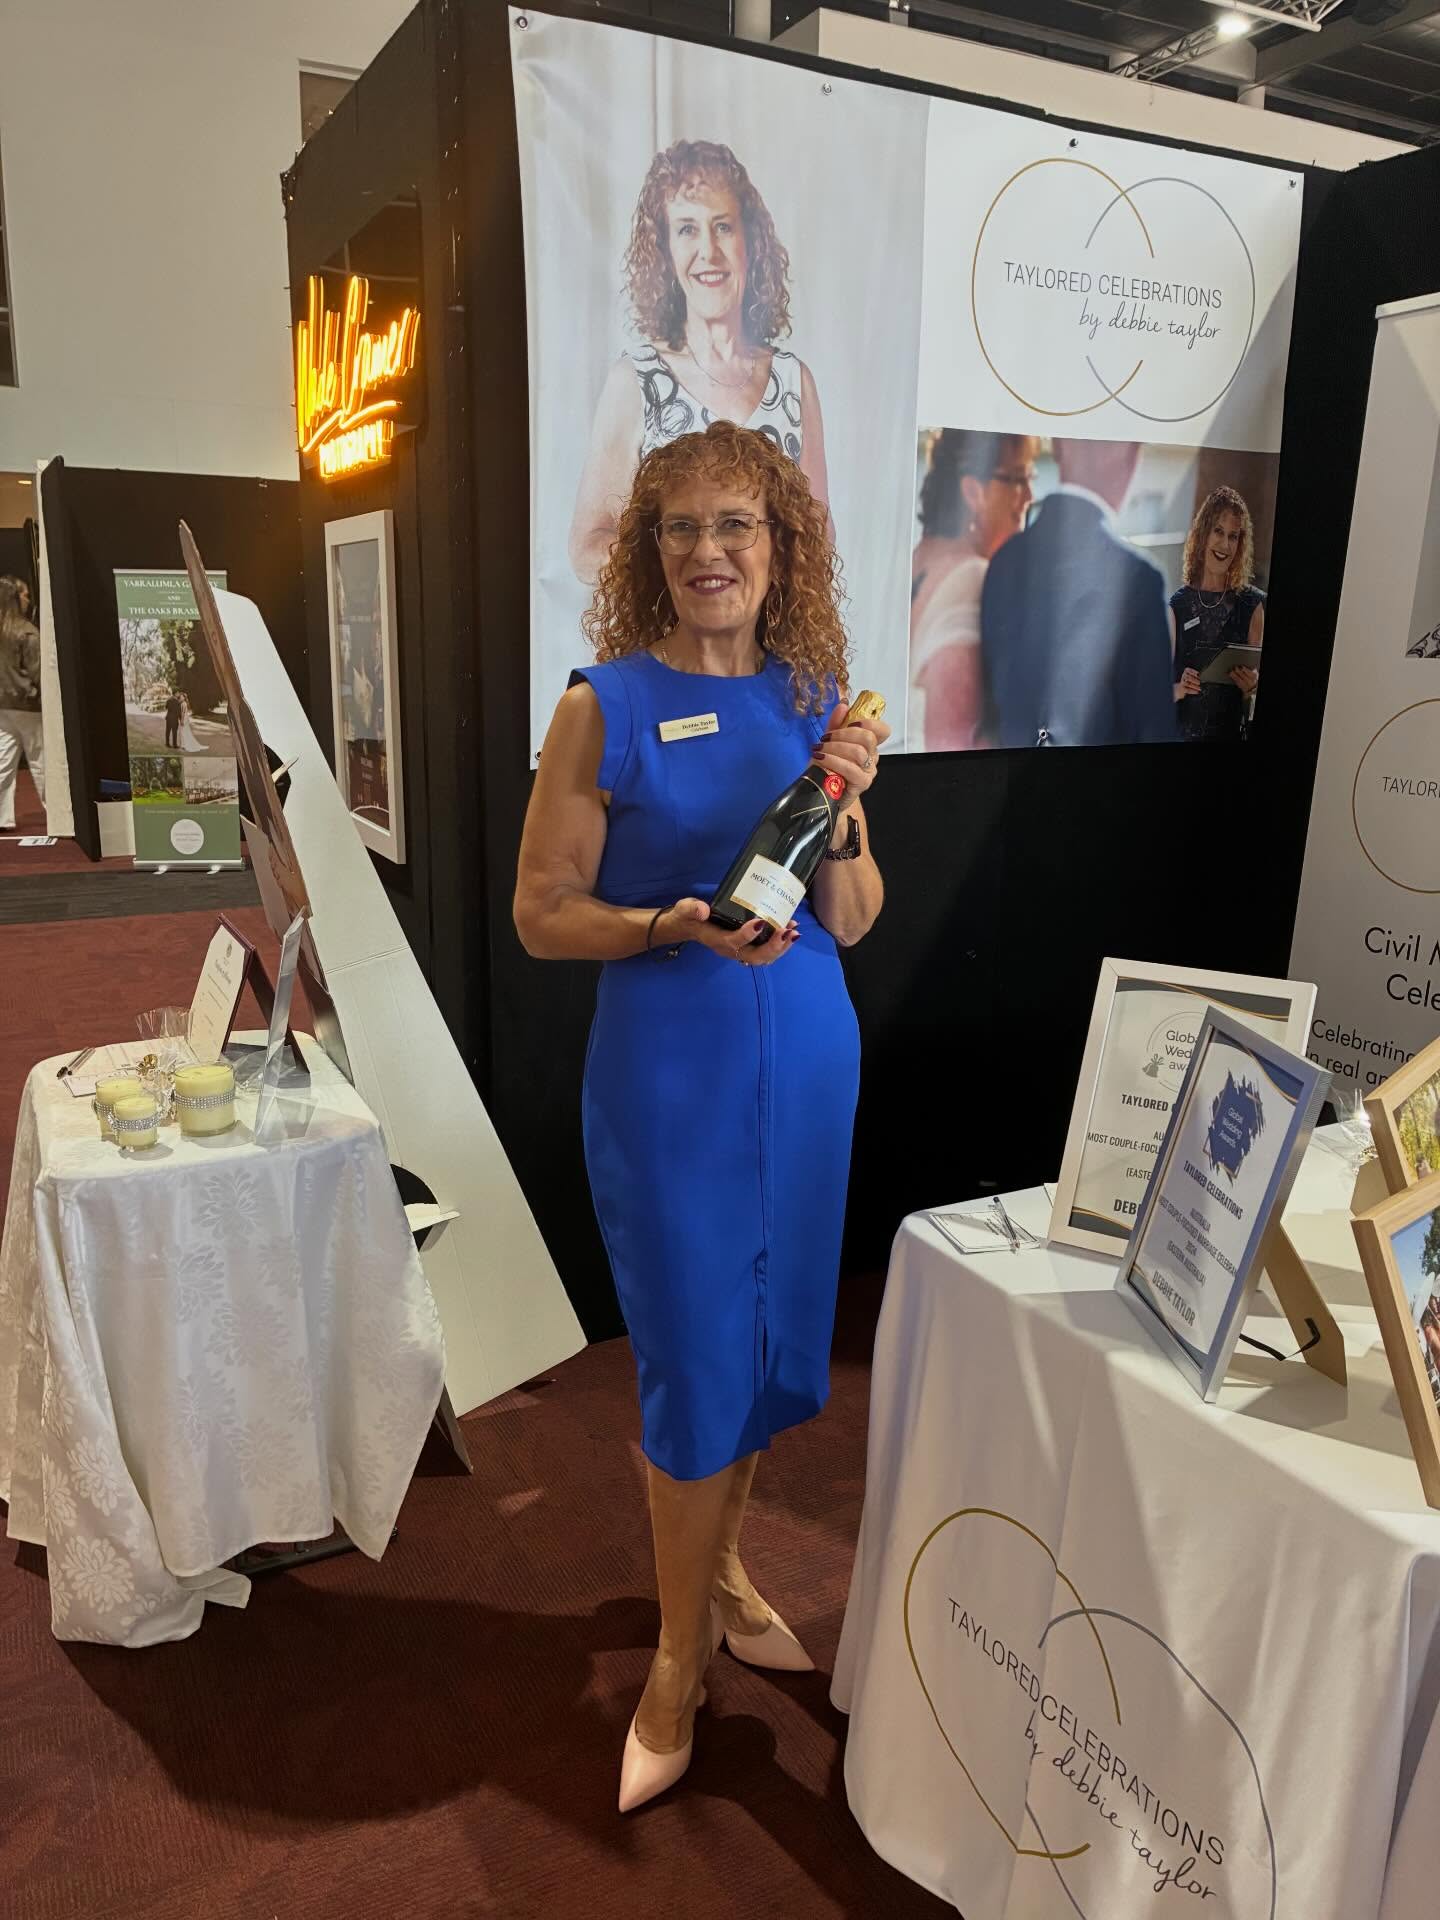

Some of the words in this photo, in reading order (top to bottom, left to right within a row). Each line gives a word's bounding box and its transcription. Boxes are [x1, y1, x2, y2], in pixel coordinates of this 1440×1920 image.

[1004, 261, 1092, 293] TAYLORED
[1099, 273, 1222, 309] CELEBRATIONS
[1079, 297, 1102, 340] by
[1108, 300, 1162, 334] debbie
[1168, 311, 1221, 350] taylor
[129, 607, 146, 615] THE
[148, 607, 171, 615] OAKS
[1382, 776, 1440, 799] TAYLOR
[1364, 926, 1421, 962] Civil
[1326, 1059, 1360, 1080] real
[1121, 1094, 1169, 1112] TAYLORED
[1087, 1132, 1108, 1144] MOST
[1184, 1160, 1206, 1188] TAYLORED
[1206, 1180, 1243, 1220] CELEBRATIONS
[1113, 1199, 1142, 1215] DEB
[1190, 1207, 1211, 1234] AUSTRALIA
[1198, 1231, 1218, 1261] MARRIAGE
[1152, 1271, 1173, 1301] DEBBIE
[1172, 1292, 1196, 1327] TAYLOR
[948, 1597, 1040, 1702] TAYLORED
[1040, 1695, 1225, 1865] CELEBRATIONS
[1052, 1746, 1124, 1829] debbie
[1130, 1828, 1217, 1901] taylor
